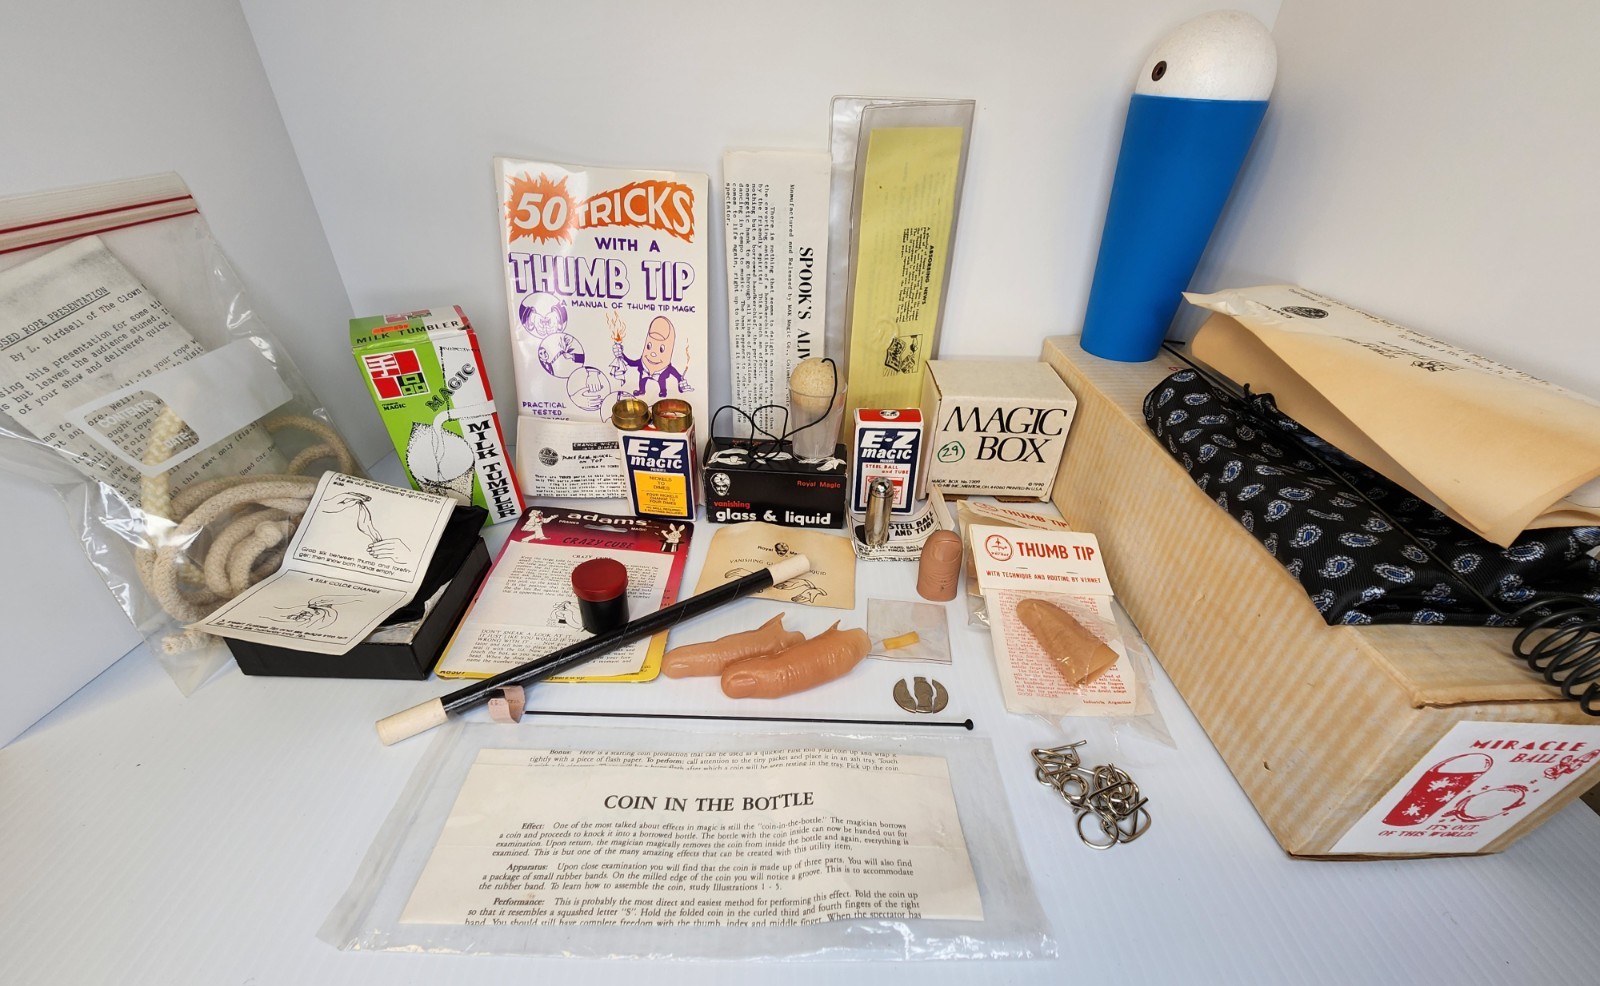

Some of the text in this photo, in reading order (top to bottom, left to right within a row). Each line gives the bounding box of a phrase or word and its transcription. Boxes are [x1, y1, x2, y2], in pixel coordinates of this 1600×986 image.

[514, 186, 692, 235] 50 TRICKS
[595, 237, 660, 252] WITH A
[508, 252, 695, 301] THUMB TIP
[924, 246, 934, 289] ABSORBING
[22, 319, 47, 334] ROPE
[47, 286, 108, 320] PRESENTATION
[572, 300, 607, 309] MANUAL
[627, 303, 656, 311] THUMB
[672, 304, 696, 312] MAGIC
[797, 247, 813, 360] SPOOK'S ALIV
[10, 352, 26, 362] By
[42, 320, 85, 344] Birdsell
[87, 311, 98, 320] of
[99, 303, 116, 313] The
[117, 289, 142, 303] Clown
[357, 320, 458, 344] MILK TUMBLER
[26, 367, 50, 381] this
[52, 331, 112, 368] presentation
[113, 321, 127, 331] for
[130, 309, 149, 321] some
[154, 344, 190, 371] your rope
[12, 390, 34, 403] but
[36, 369, 70, 390] leaves
[72, 358, 89, 368] the
[91, 334, 128, 357] audience
[19, 404, 32, 414] of
[35, 389, 59, 406] your
[62, 374, 83, 389] show
[86, 361, 103, 374] and
[105, 335, 144, 362] delivered
[425, 363, 476, 412] MAGIC
[942, 406, 1068, 436] MAGIC
[219, 443, 234, 456] only
[627, 438, 685, 459] E-Z
[860, 431, 918, 449] E-Z
[974, 436, 1052, 463] BOX
[942, 445, 959, 457] 29
[468, 420, 516, 518] MILK TUMBLER
[714, 501, 750, 510] vanishing
[568, 513, 647, 526] adams
[716, 508, 831, 525] glass & liquid
[915, 518, 934, 534] TUBE
[916, 511, 933, 527] BALL
[1000, 509, 1046, 522] THUMB
[1051, 520, 1068, 528] TIP
[563, 537, 602, 546] CRAZY
[1016, 542, 1094, 560] THUMB TIP
[1002, 571, 1032, 579] TECHNIQUE
[1469, 740, 1587, 751] MIRACLE
[1509, 753, 1558, 763] BALL
[604, 792, 814, 812] COIN IN THE BOTTLE
[880, 821, 906, 829] borrows
[506, 863, 578, 872] Apparatus: Upon
